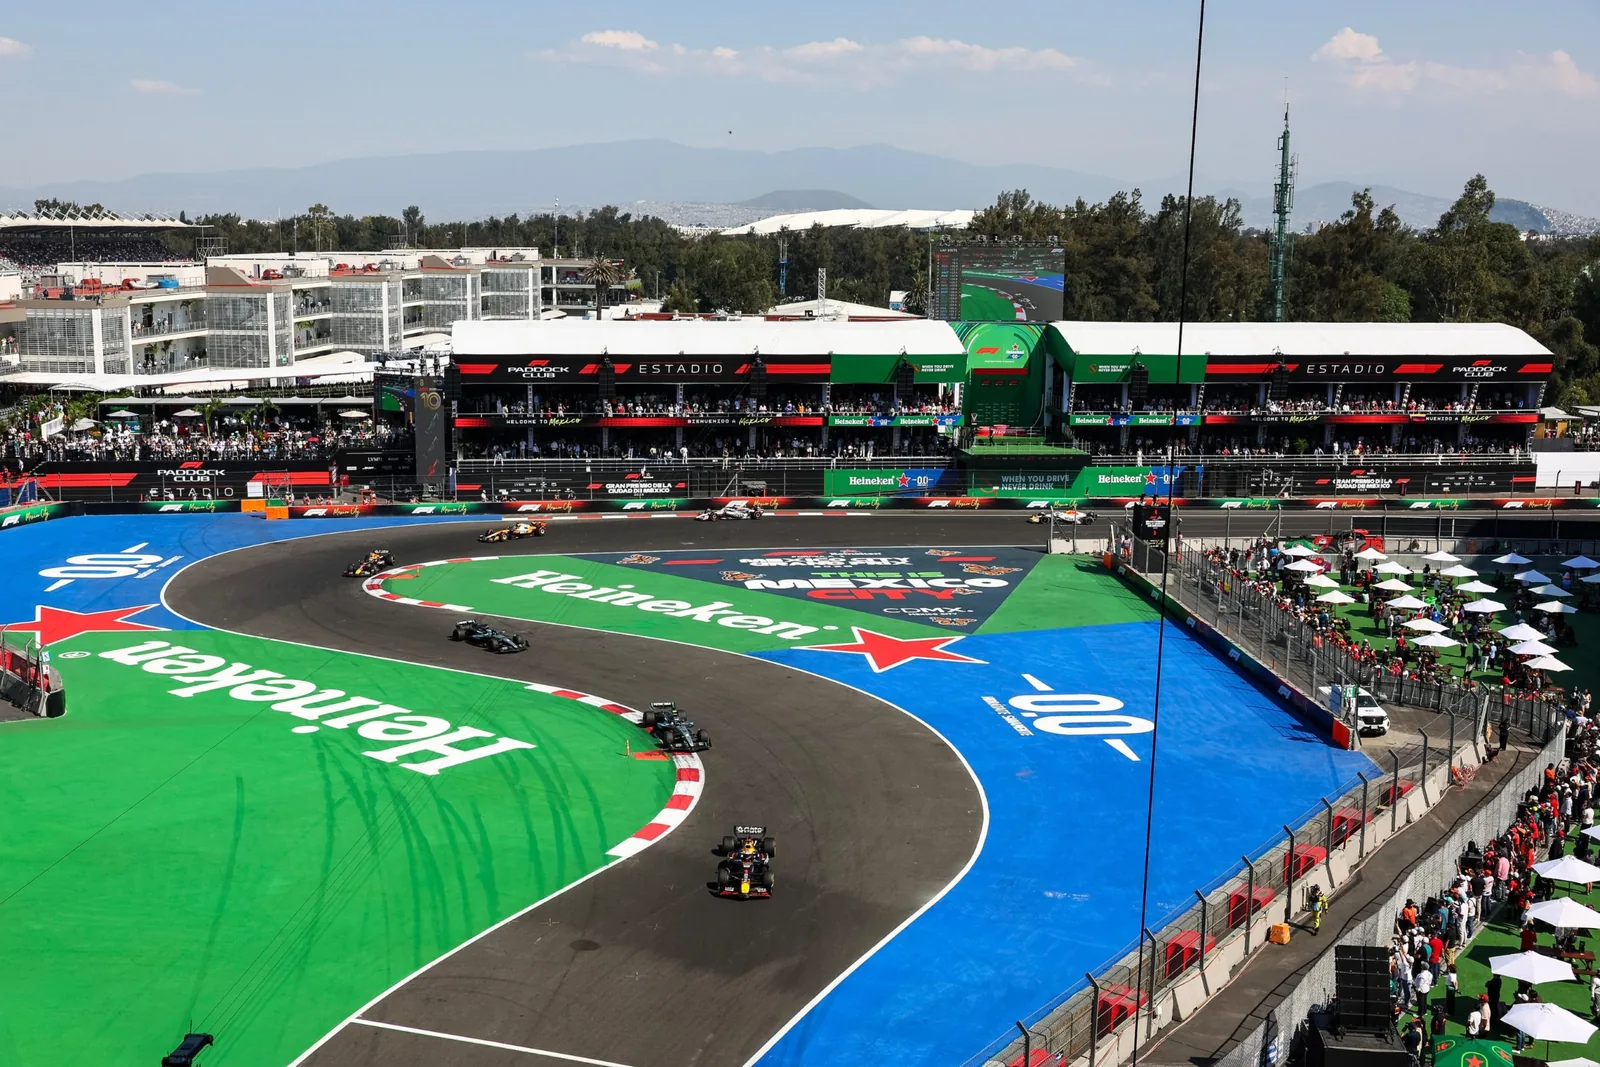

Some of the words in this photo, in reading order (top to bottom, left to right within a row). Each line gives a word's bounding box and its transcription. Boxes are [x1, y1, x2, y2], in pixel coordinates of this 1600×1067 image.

[639, 364, 723, 373] ESTADIO
[1306, 365, 1385, 373] ESTADIO
[420, 392, 441, 409] 10
[850, 476, 894, 485] Heineken
[1098, 474, 1142, 483] Heineken
[150, 488, 234, 496] ESTADIO
[744, 578, 1009, 589] MEXICO
[806, 589, 956, 599] CITY
[489, 570, 819, 640] Heineken
[98, 640, 537, 775] Heineken
[1008, 694, 1155, 736] 0.0
